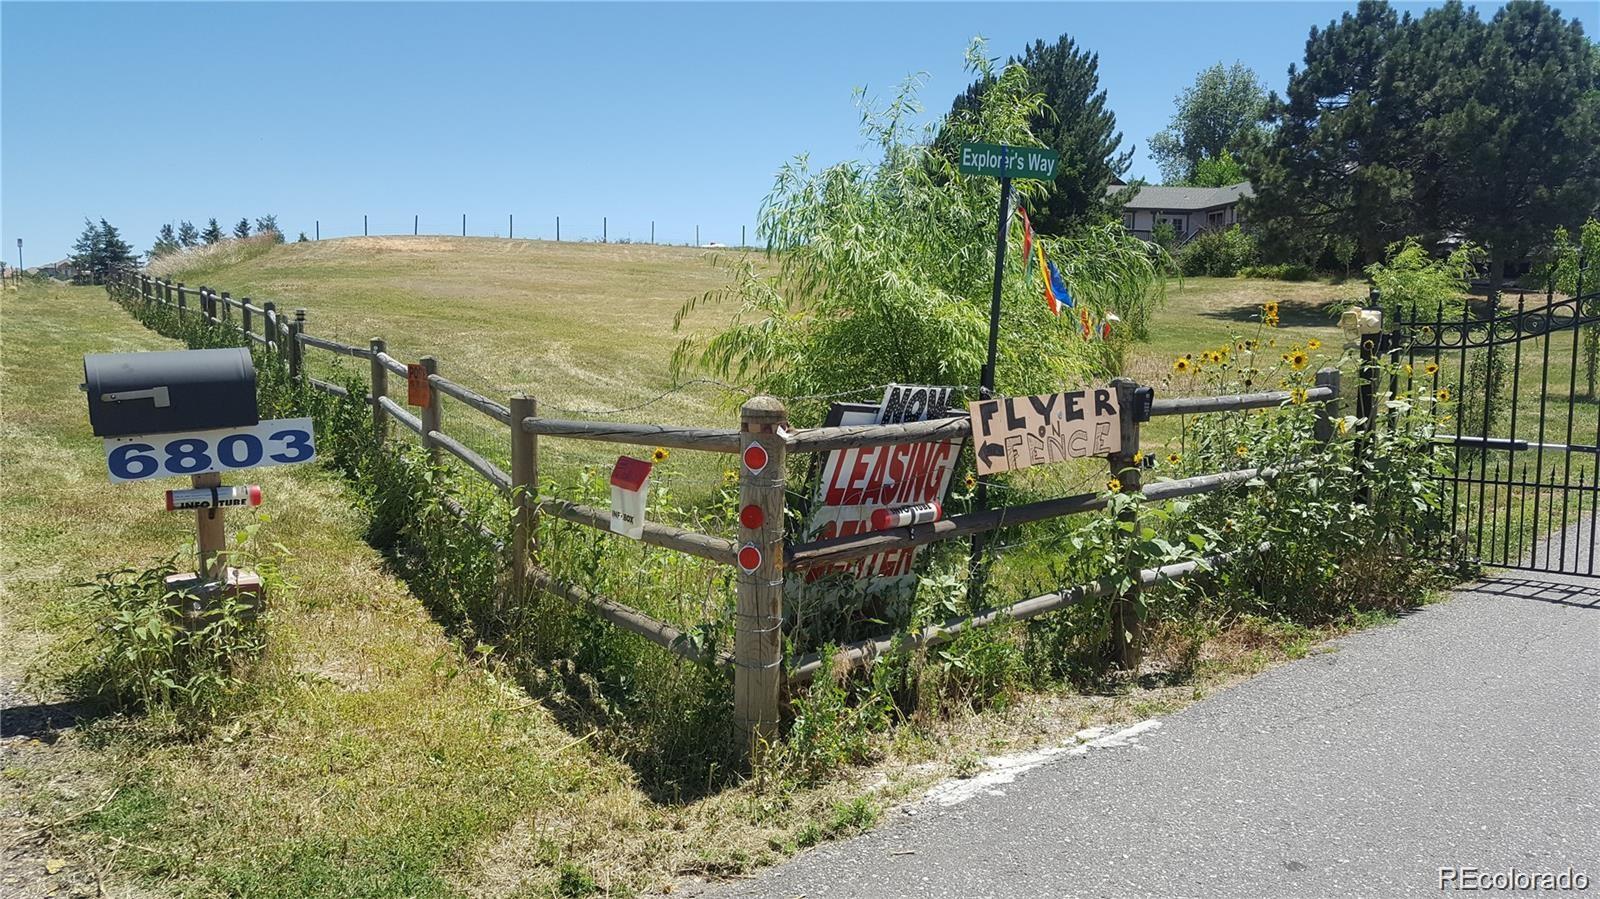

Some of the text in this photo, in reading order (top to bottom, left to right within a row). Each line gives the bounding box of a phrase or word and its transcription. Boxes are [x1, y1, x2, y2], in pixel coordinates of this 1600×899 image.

[1028, 153, 1055, 176] Way
[881, 387, 951, 424] NOW
[979, 389, 1117, 436] FLYER
[1004, 421, 1111, 470] FENCE
[1038, 420, 1061, 438] ON
[108, 429, 315, 479] 6803
[825, 438, 952, 506] LEASING
[179, 498, 247, 509] INFO TUBE
